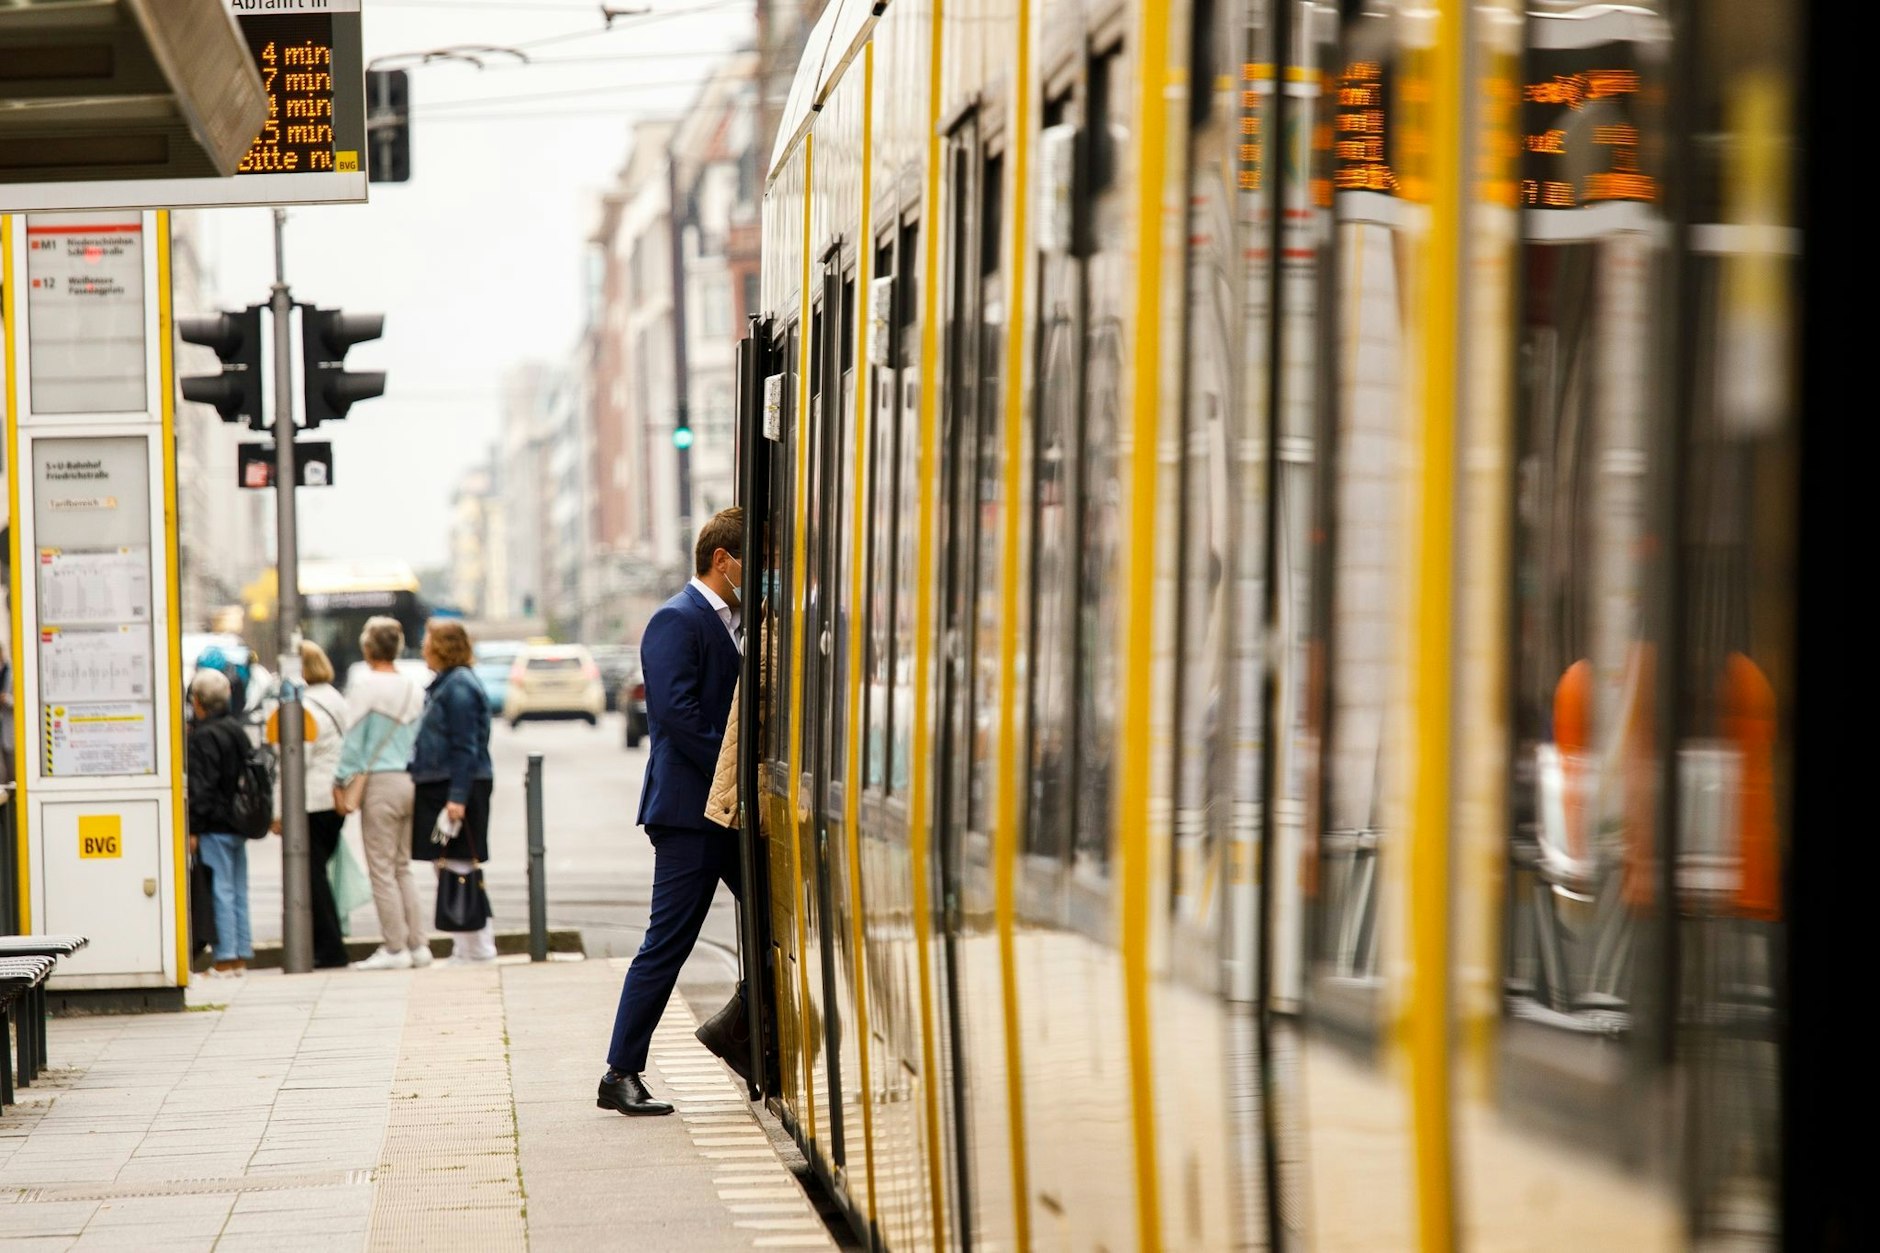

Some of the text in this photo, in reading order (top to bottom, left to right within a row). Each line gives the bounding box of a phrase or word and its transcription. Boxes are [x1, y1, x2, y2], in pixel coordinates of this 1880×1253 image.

[262, 41, 330, 65] 4 min
[263, 67, 331, 91] 7 min
[287, 93, 332, 117] min
[288, 119, 333, 143] min
[339, 161, 356, 170] BVG
[41, 240, 56, 250] M1
[44, 278, 55, 289] 12
[85, 836, 117, 854] BVG
